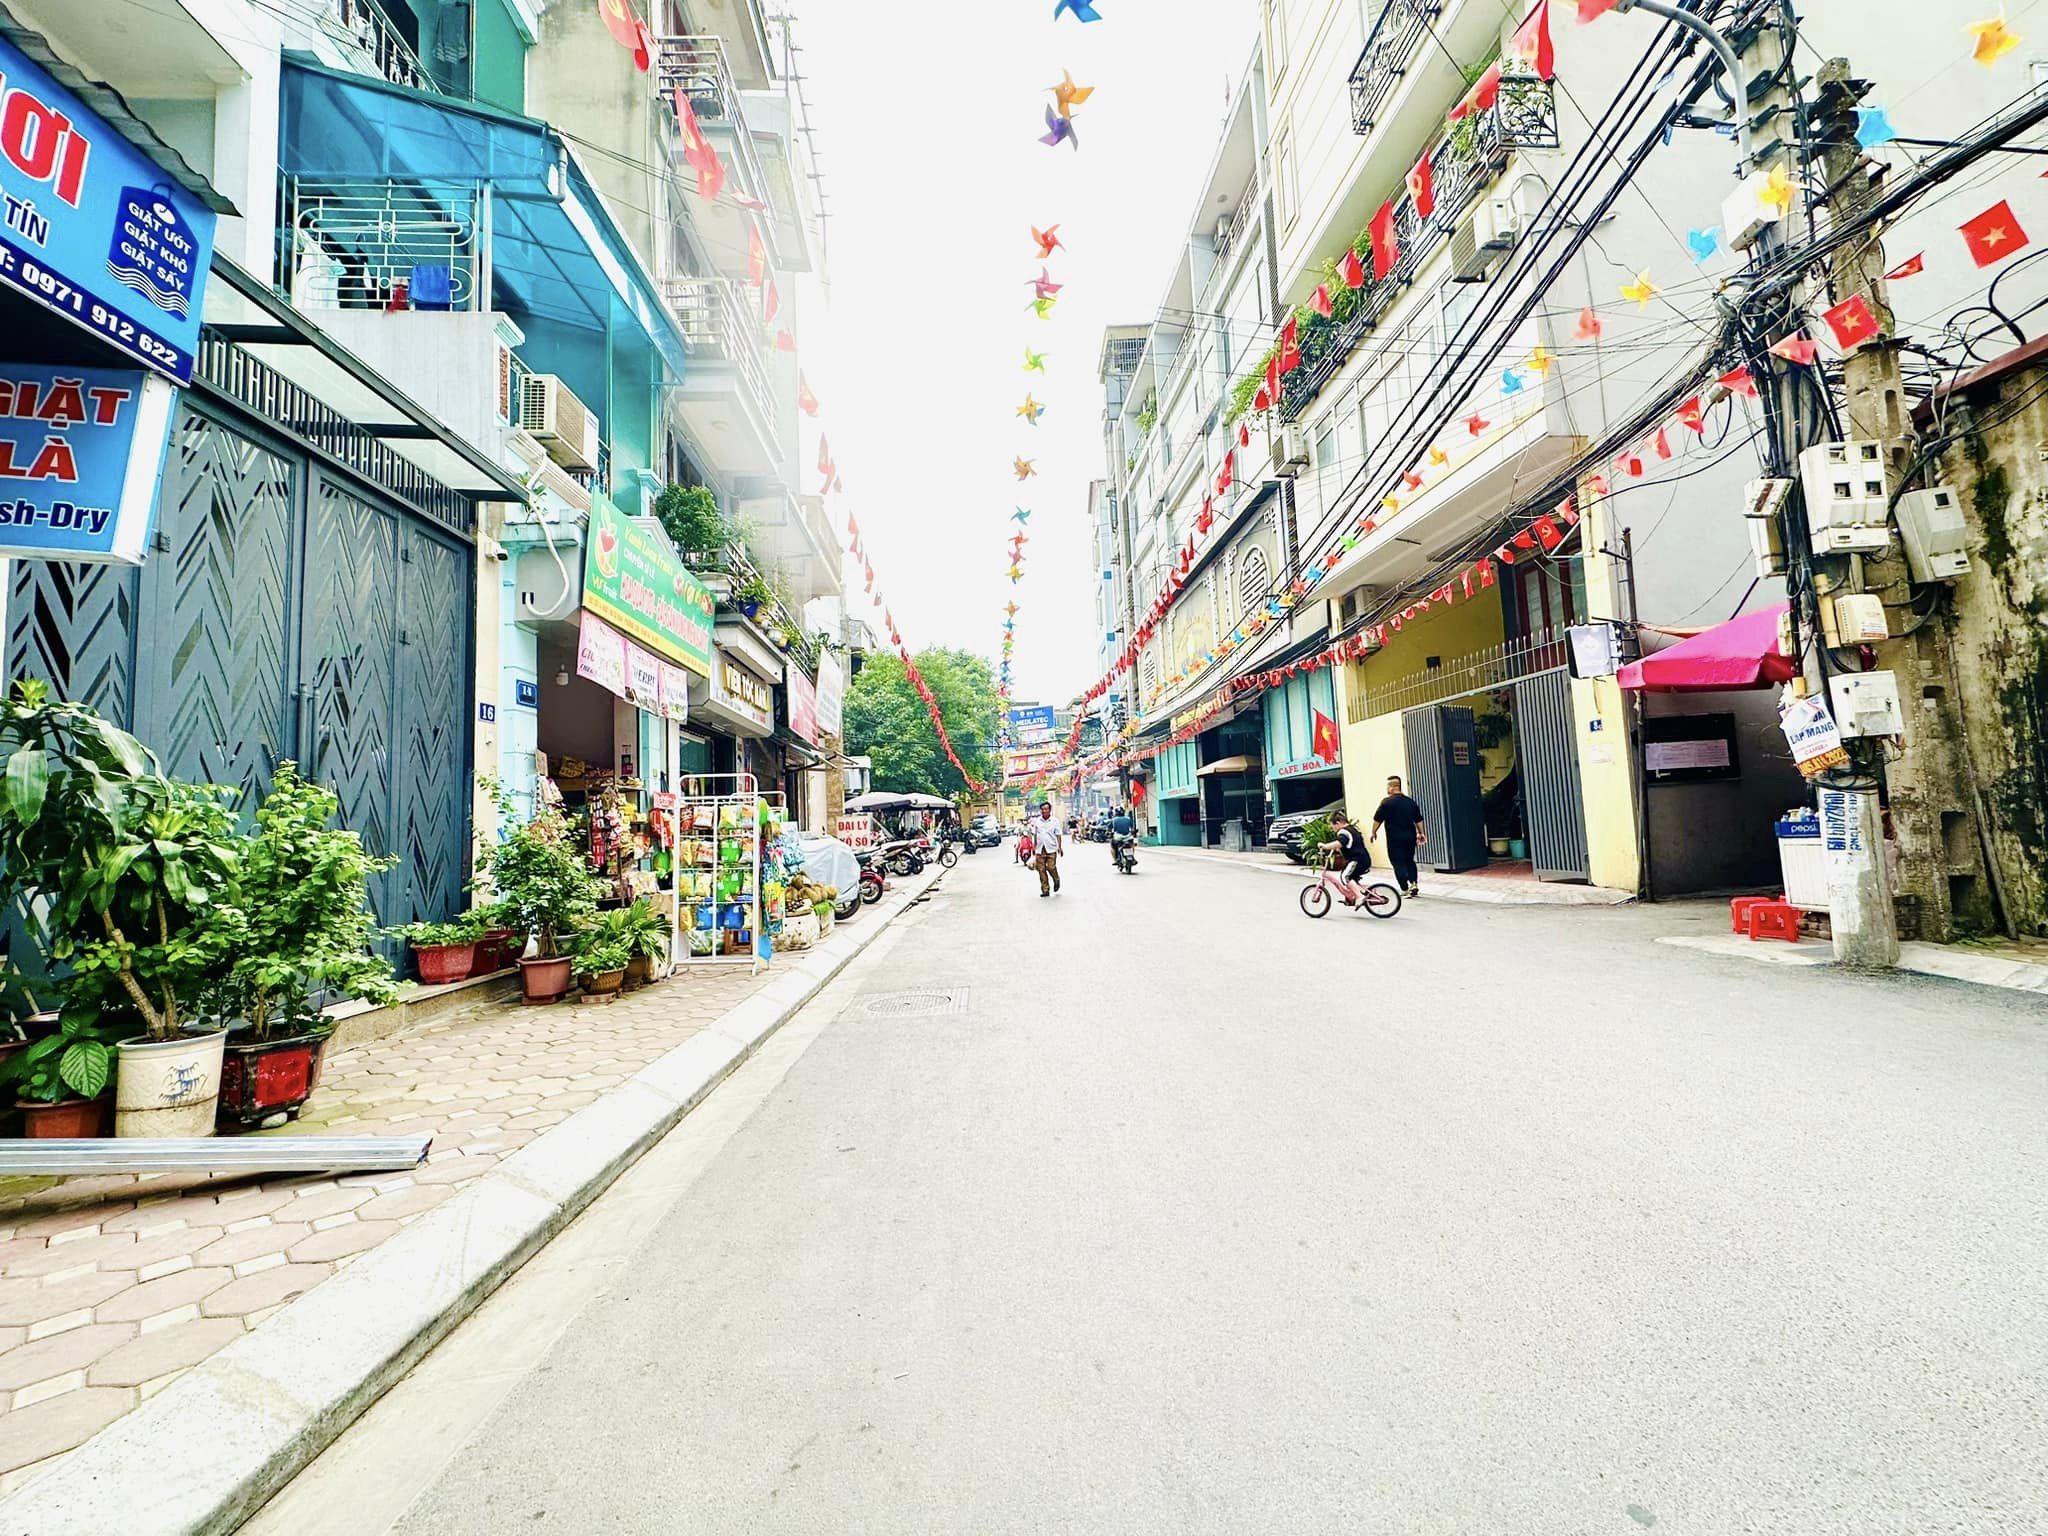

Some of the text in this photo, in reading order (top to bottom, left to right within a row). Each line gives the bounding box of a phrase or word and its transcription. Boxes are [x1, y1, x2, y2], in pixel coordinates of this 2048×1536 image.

[0, 70, 90, 208] ƠI
[5, 193, 49, 247] TÍN
[128, 202, 162, 232] GIẶT
[121, 241, 185, 291] GIẶT SẤY
[124, 221, 188, 274] GIẶT KHÔ
[22, 262, 83, 311] 0971
[91, 304, 135, 343] 912
[138, 333, 179, 368] 622
[0, 376, 130, 429] GIẶT
[0, 436, 78, 483] LÀ
[482, 705, 494, 720] 16
[1016, 716, 1049, 726] MEDLATEC
[1279, 764, 1299, 775] CAFE
[1302, 761, 1321, 771] HOA
[1791, 824, 1817, 834] pepsi
